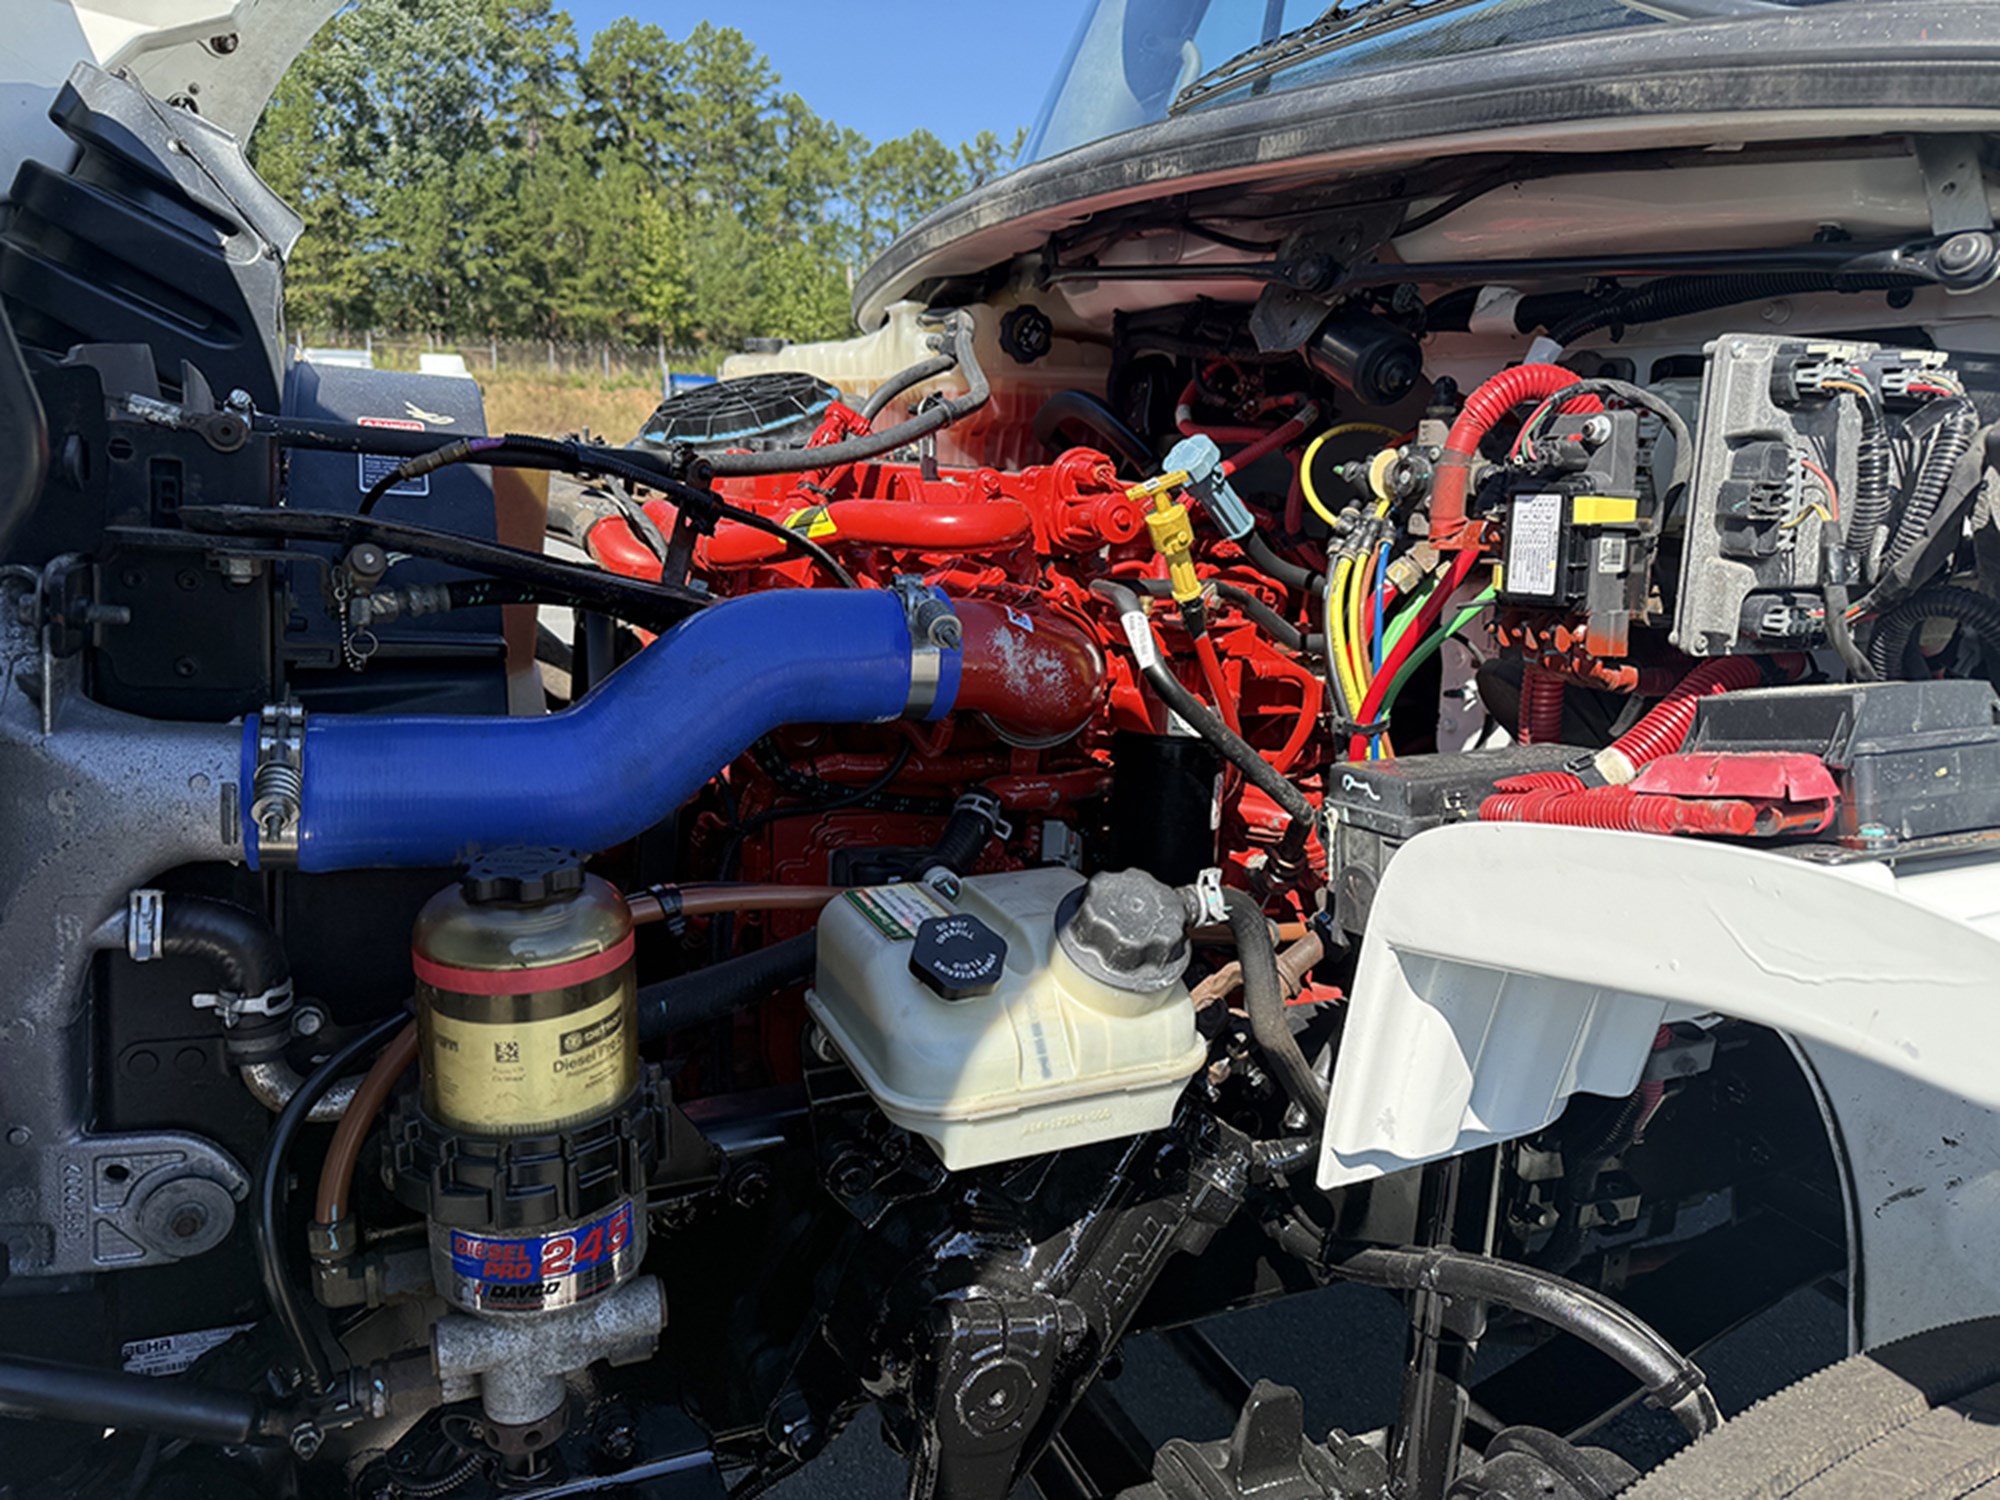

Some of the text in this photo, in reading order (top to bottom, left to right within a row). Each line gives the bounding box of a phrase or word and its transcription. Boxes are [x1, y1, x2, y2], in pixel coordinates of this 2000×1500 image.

[553, 1048, 596, 1073] Diesel
[455, 1237, 530, 1262] DIESEL
[483, 1209, 629, 1279] PRO 245
[489, 1281, 560, 1299] DAVCO
